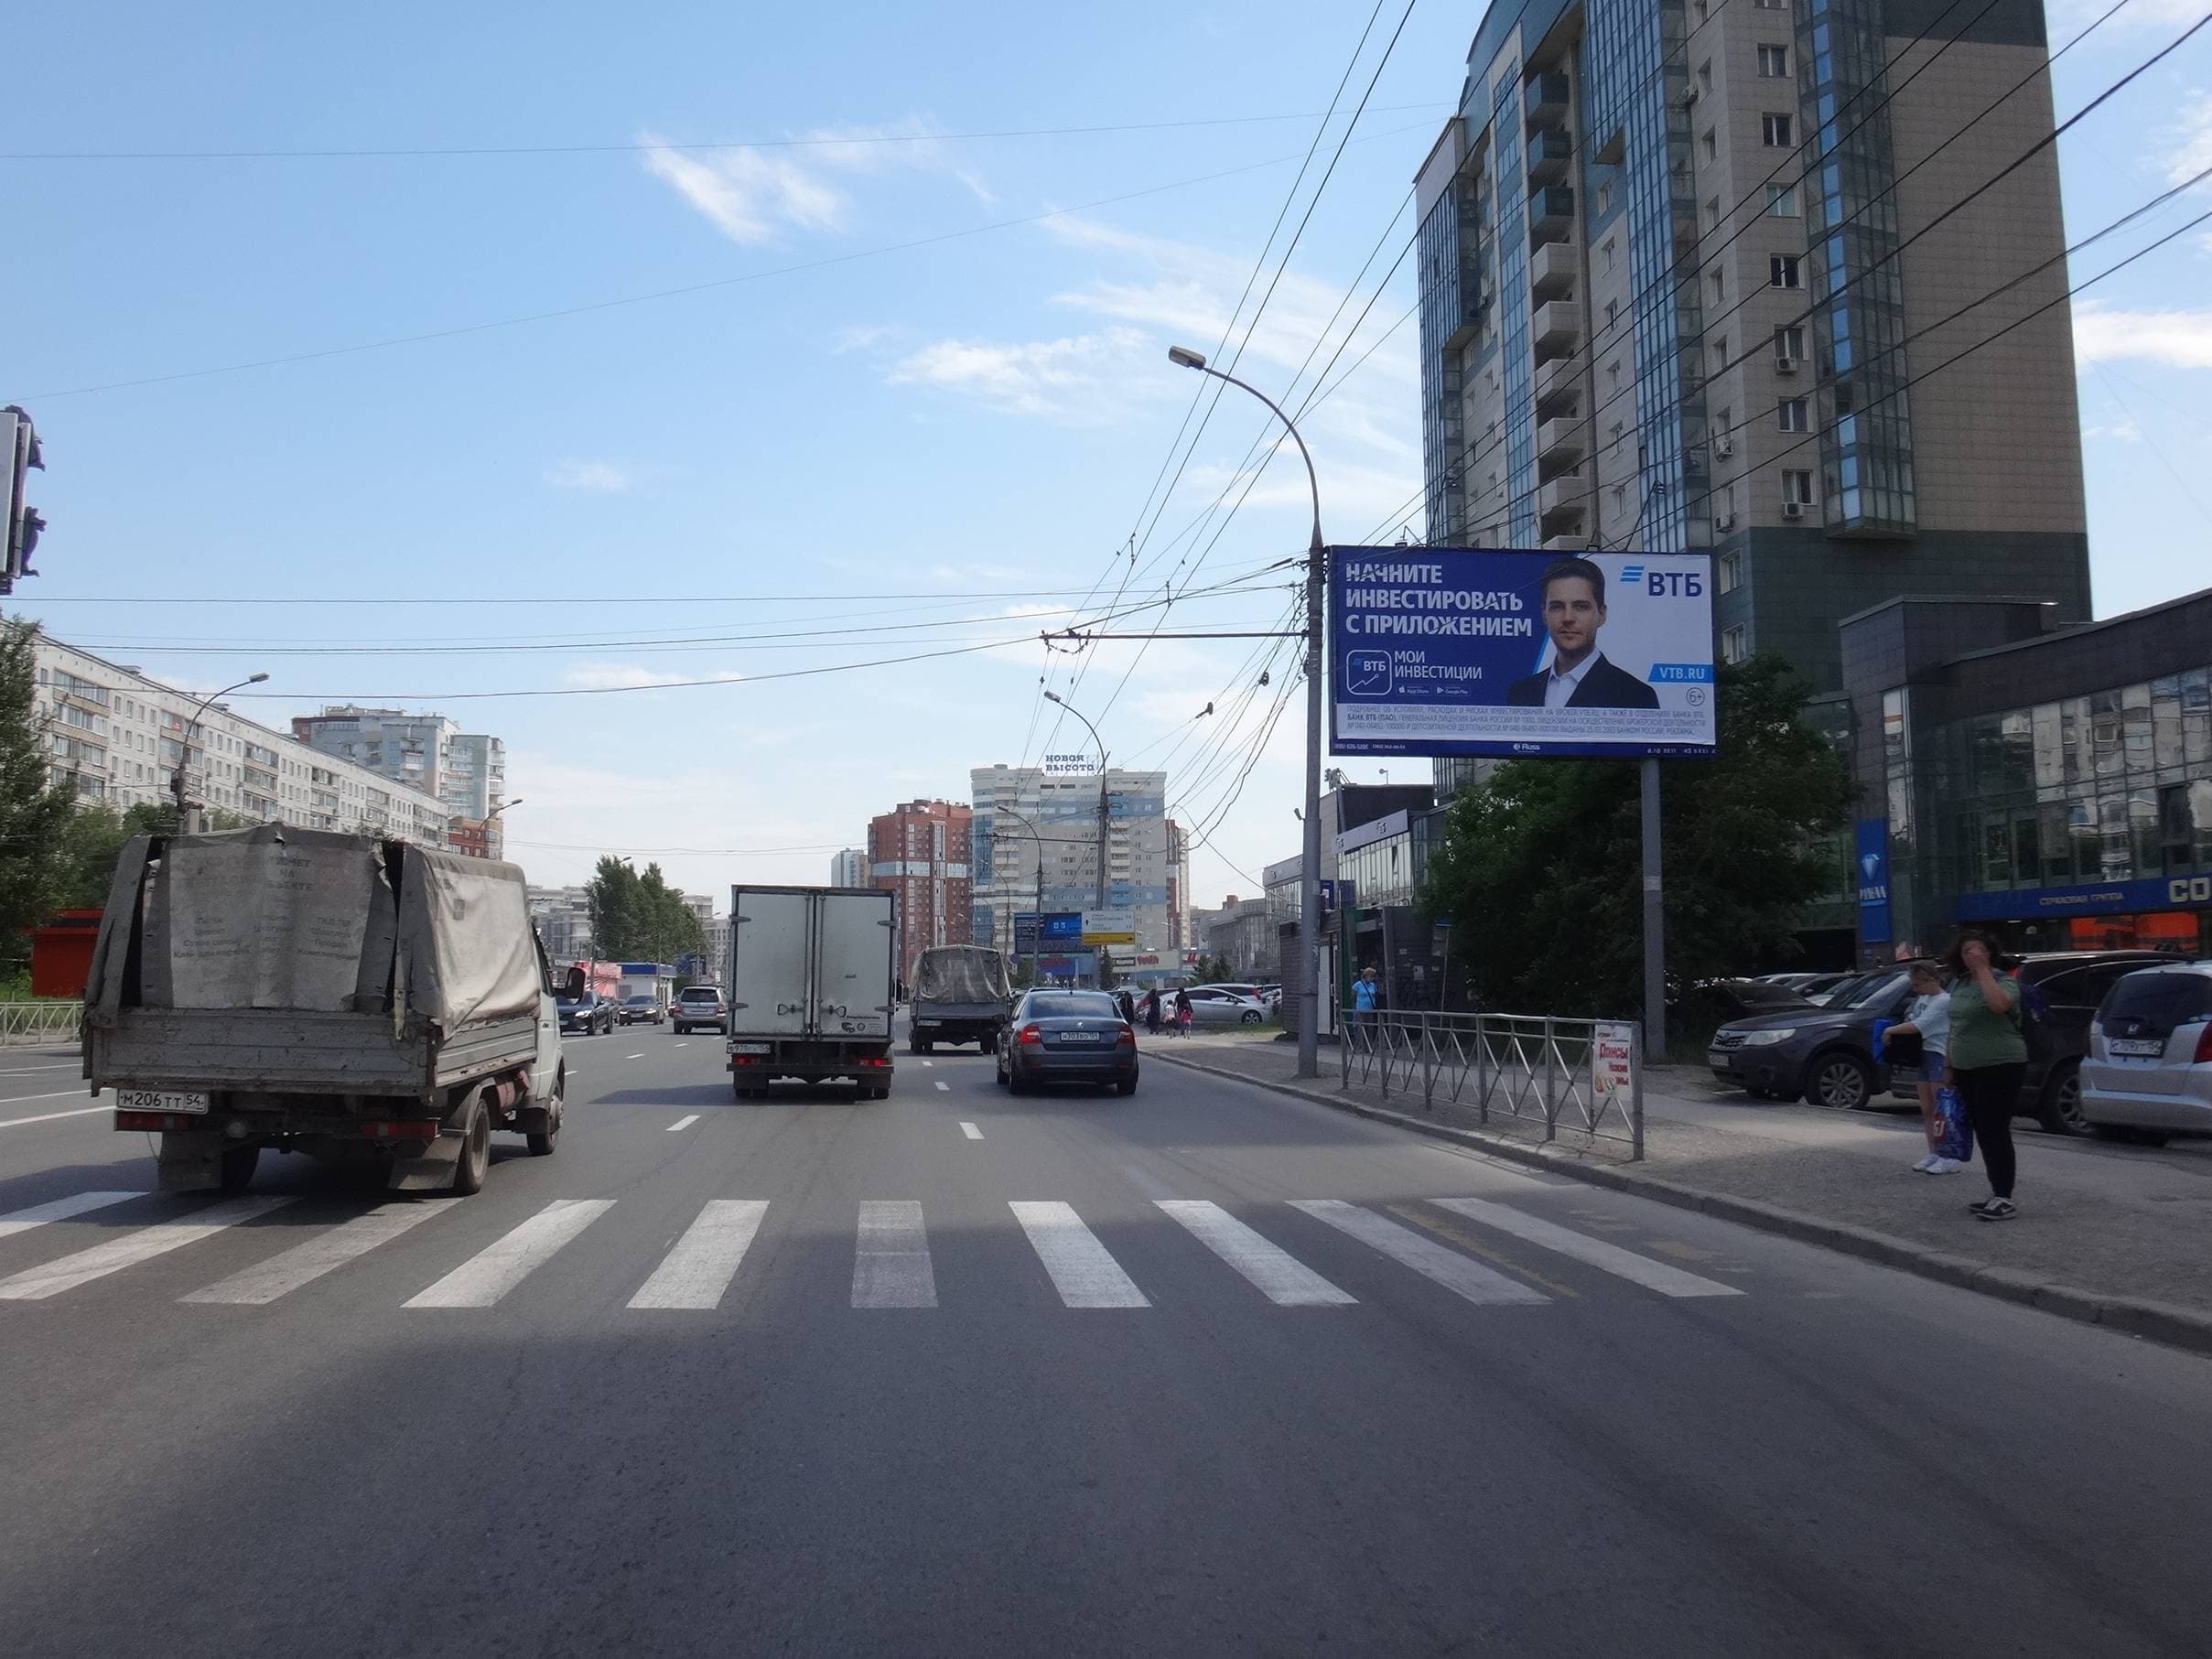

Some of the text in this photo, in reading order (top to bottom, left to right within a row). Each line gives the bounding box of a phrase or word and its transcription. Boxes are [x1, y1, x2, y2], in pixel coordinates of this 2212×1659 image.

[1345, 563, 1443, 584] НАЧНИТЕ
[1648, 572, 1702, 597] ВТБ
[1345, 588, 1523, 611] ИНВЕСТИРОВАТЬ
[1345, 614, 1532, 637] С ПРИЛОЖЕНИЕМ
[1364, 661, 1387, 672] ВТБ
[1394, 651, 1426, 663] МОИ
[1394, 665, 1483, 682] ИНВЕСТИЦИИ
[1659, 667, 1706, 680] VTB.RU
